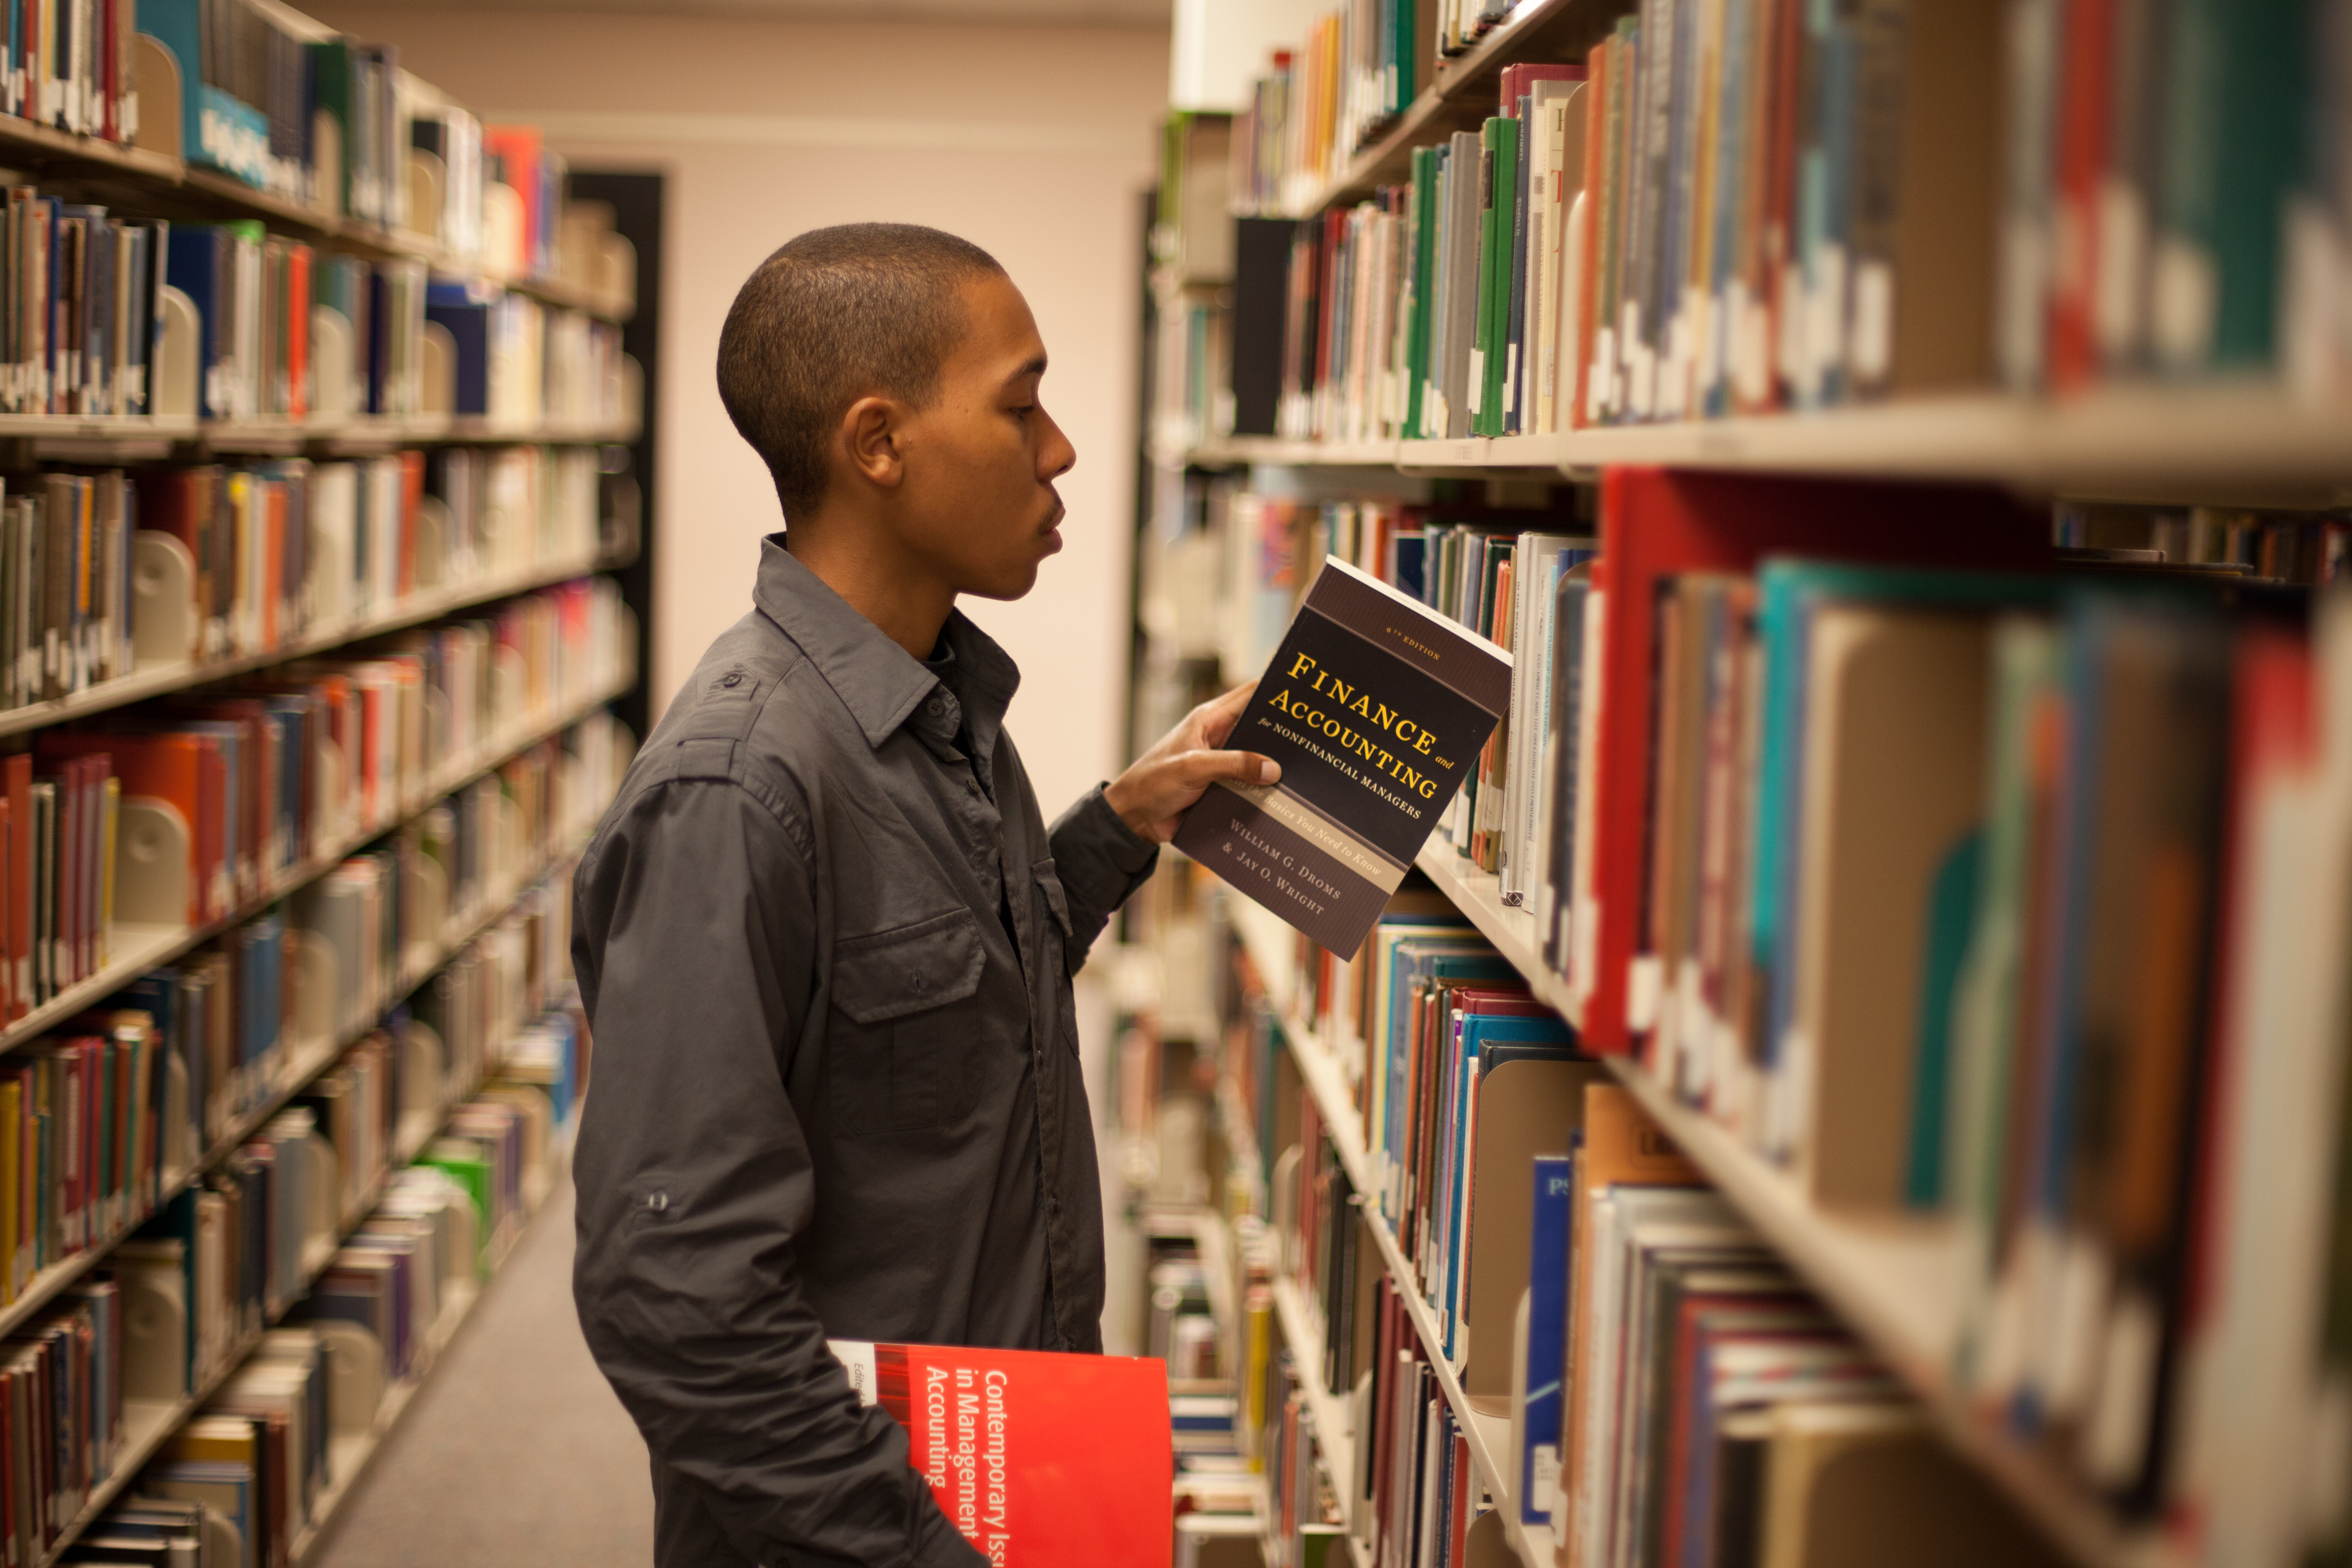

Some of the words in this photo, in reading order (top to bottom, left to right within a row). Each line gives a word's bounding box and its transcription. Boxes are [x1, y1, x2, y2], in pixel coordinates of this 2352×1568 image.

[1516, 581, 1520, 590] IN
[1403, 636, 1440, 660] EDITION
[1514, 640, 1518, 652] OF
[1546, 661, 1551, 675] OF
[1269, 689, 1437, 799] ACCOUNTING
[1287, 652, 1436, 755] FINANCE
[1435, 756, 1455, 770] and
[1257, 717, 1272, 727] for
[1273, 723, 1358, 780] NONFINANCIAL
[1360, 776, 1421, 819] MANAGERS
[1531, 770, 1536, 779] OF
[1230, 819, 1282, 860] WILLIAM
[1282, 856, 1294, 871] G.
[1298, 866, 1341, 899] DROMS
[1264, 795, 1295, 819] Basics
[1296, 815, 1315, 833] You
[1315, 828, 1343, 850] Need
[1343, 846, 1352, 857] to
[1352, 853, 1381, 875] Know
[1222, 842, 1232, 854] &
[1236, 852, 1259, 871] JAY
[1260, 867, 1271, 882] O.
[1276, 876, 1324, 915] WRIGHT
[956, 1369, 978, 1387] in
[925, 1366, 951, 1488] Accounting
[953, 1393, 979, 1538] Management
[983, 1370, 1007, 1528] Contemporary
